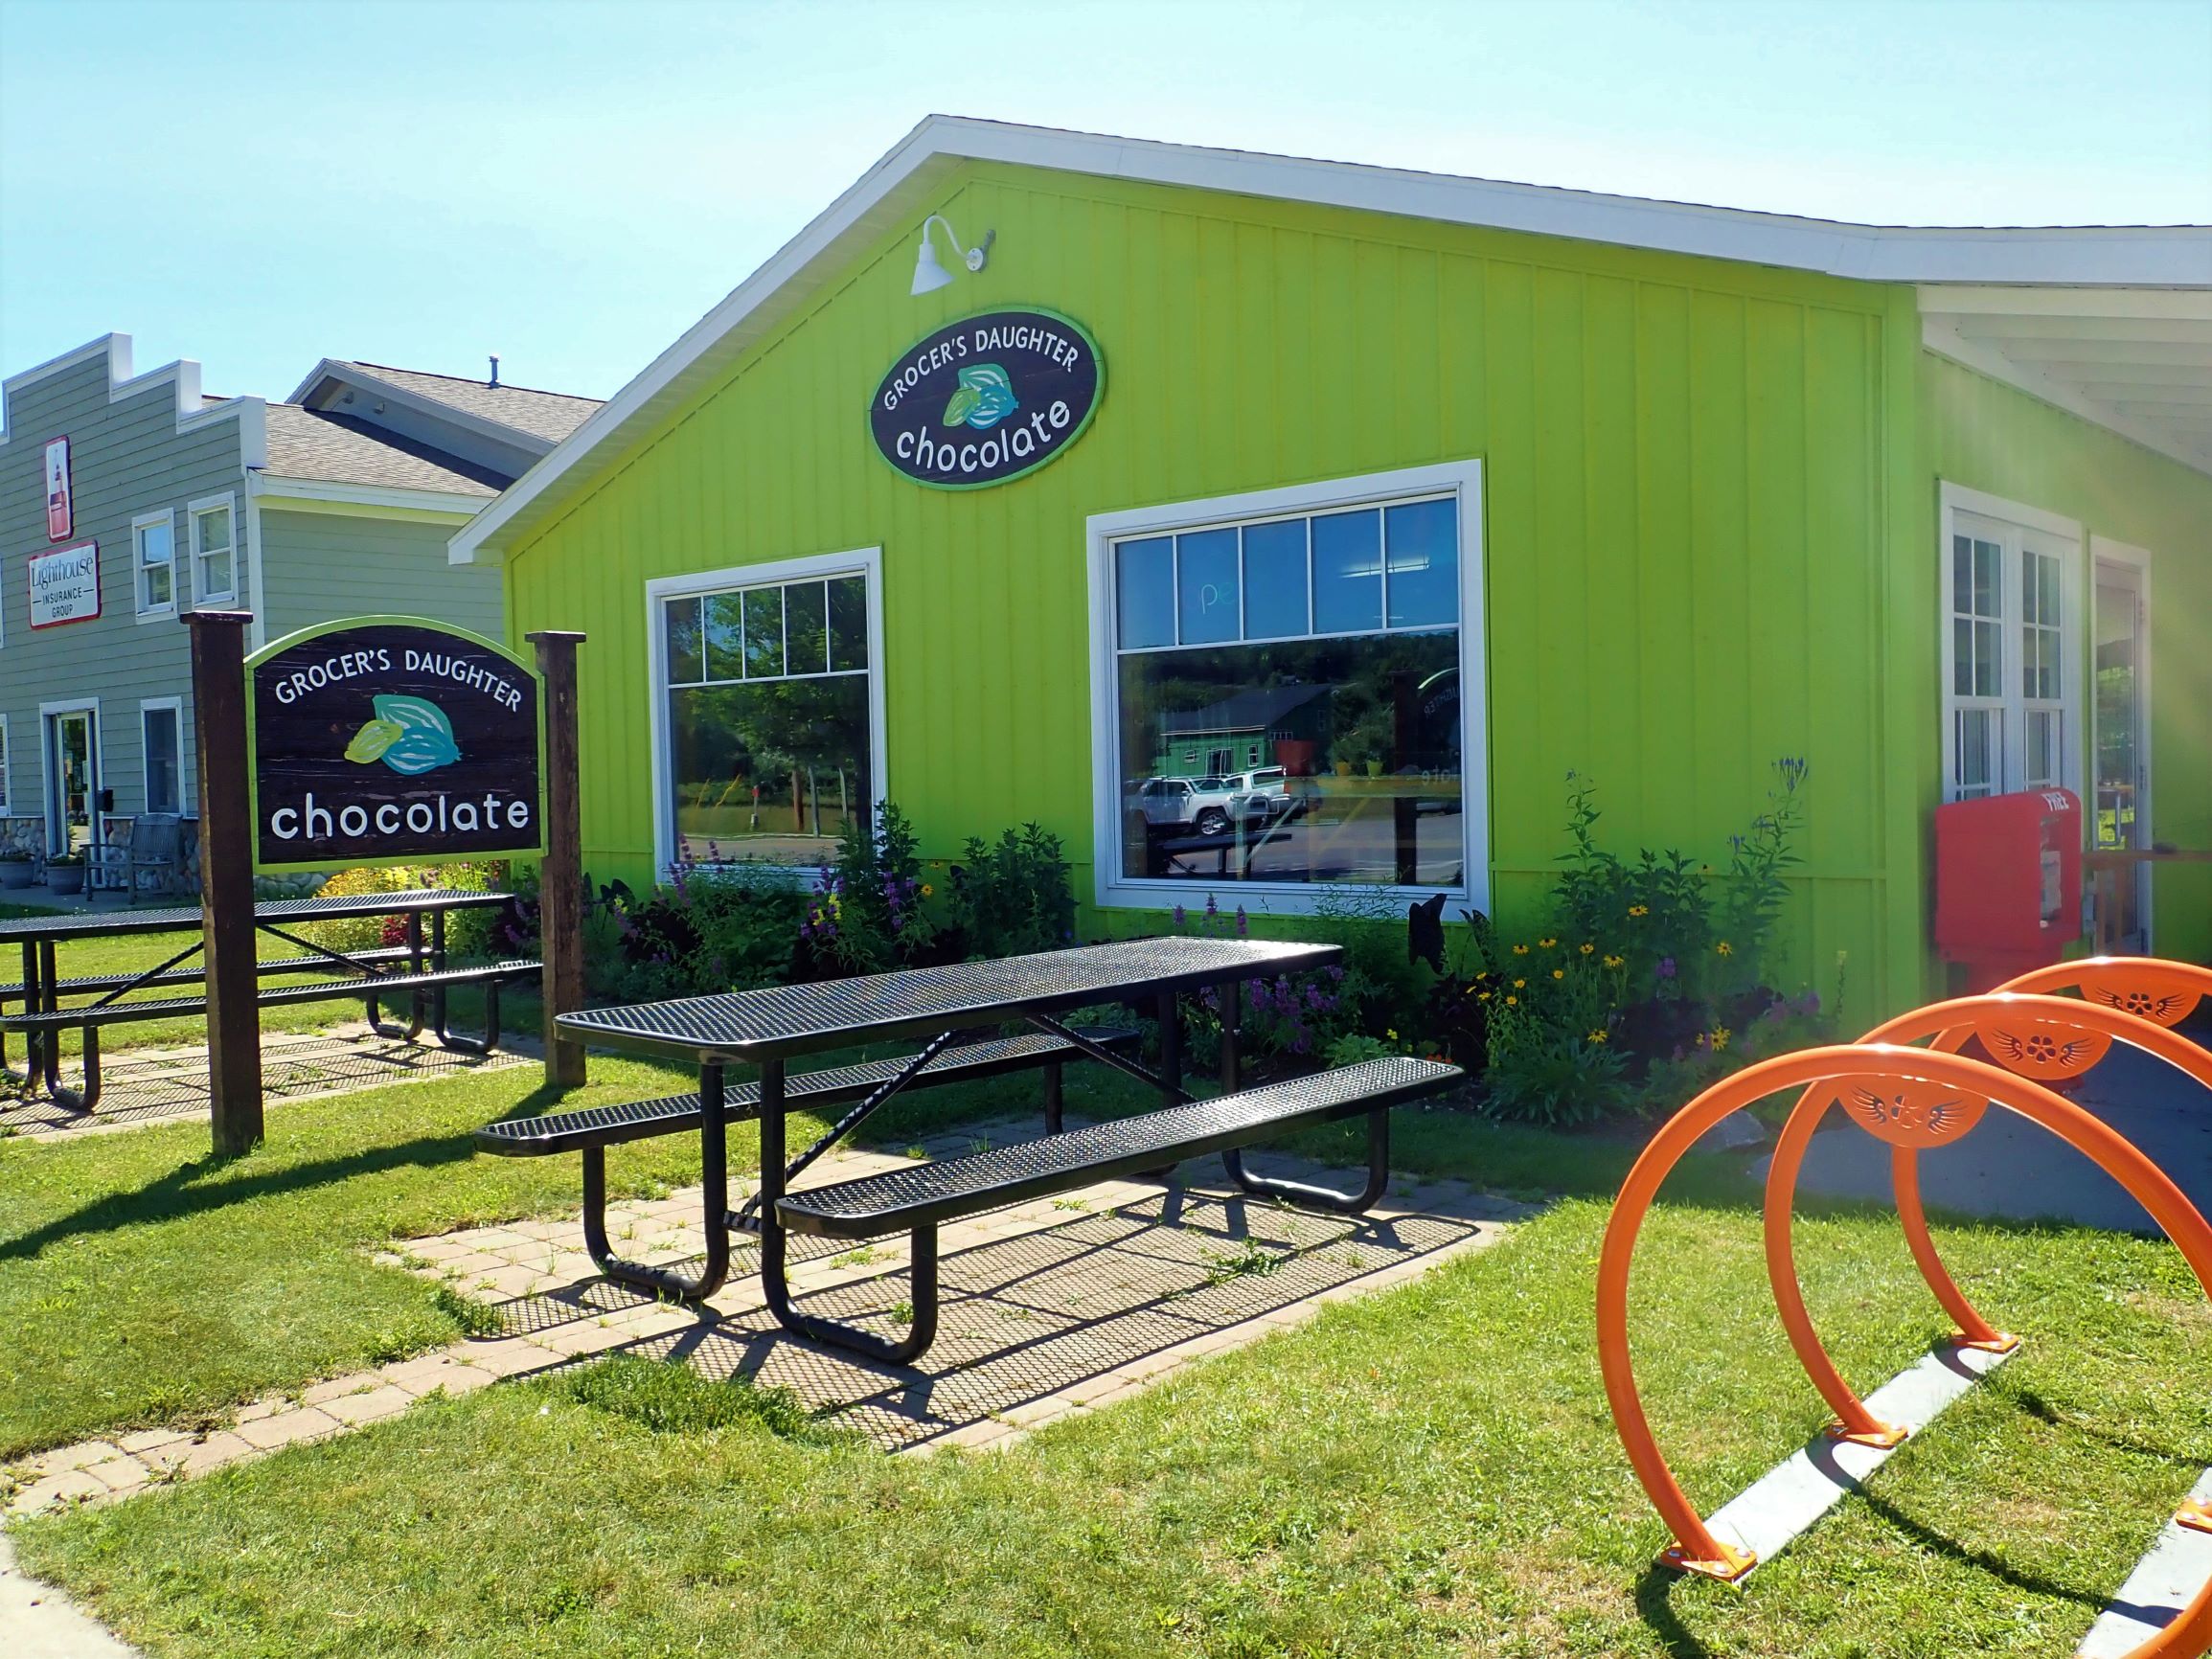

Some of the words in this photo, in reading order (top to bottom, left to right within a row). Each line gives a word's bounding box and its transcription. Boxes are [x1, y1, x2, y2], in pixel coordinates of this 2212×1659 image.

[883, 335, 968, 411] GROCER'S
[975, 326, 1079, 373] DAUGHTER
[896, 400, 1070, 472] chocolate
[32, 557, 93, 590] Lighthouse
[42, 586, 82, 605] INSURANCE
[52, 603, 73, 618] GROUP
[275, 648, 391, 704] GROCER'S
[405, 649, 522, 713] DAUGHTER
[271, 791, 529, 839] chocolate
